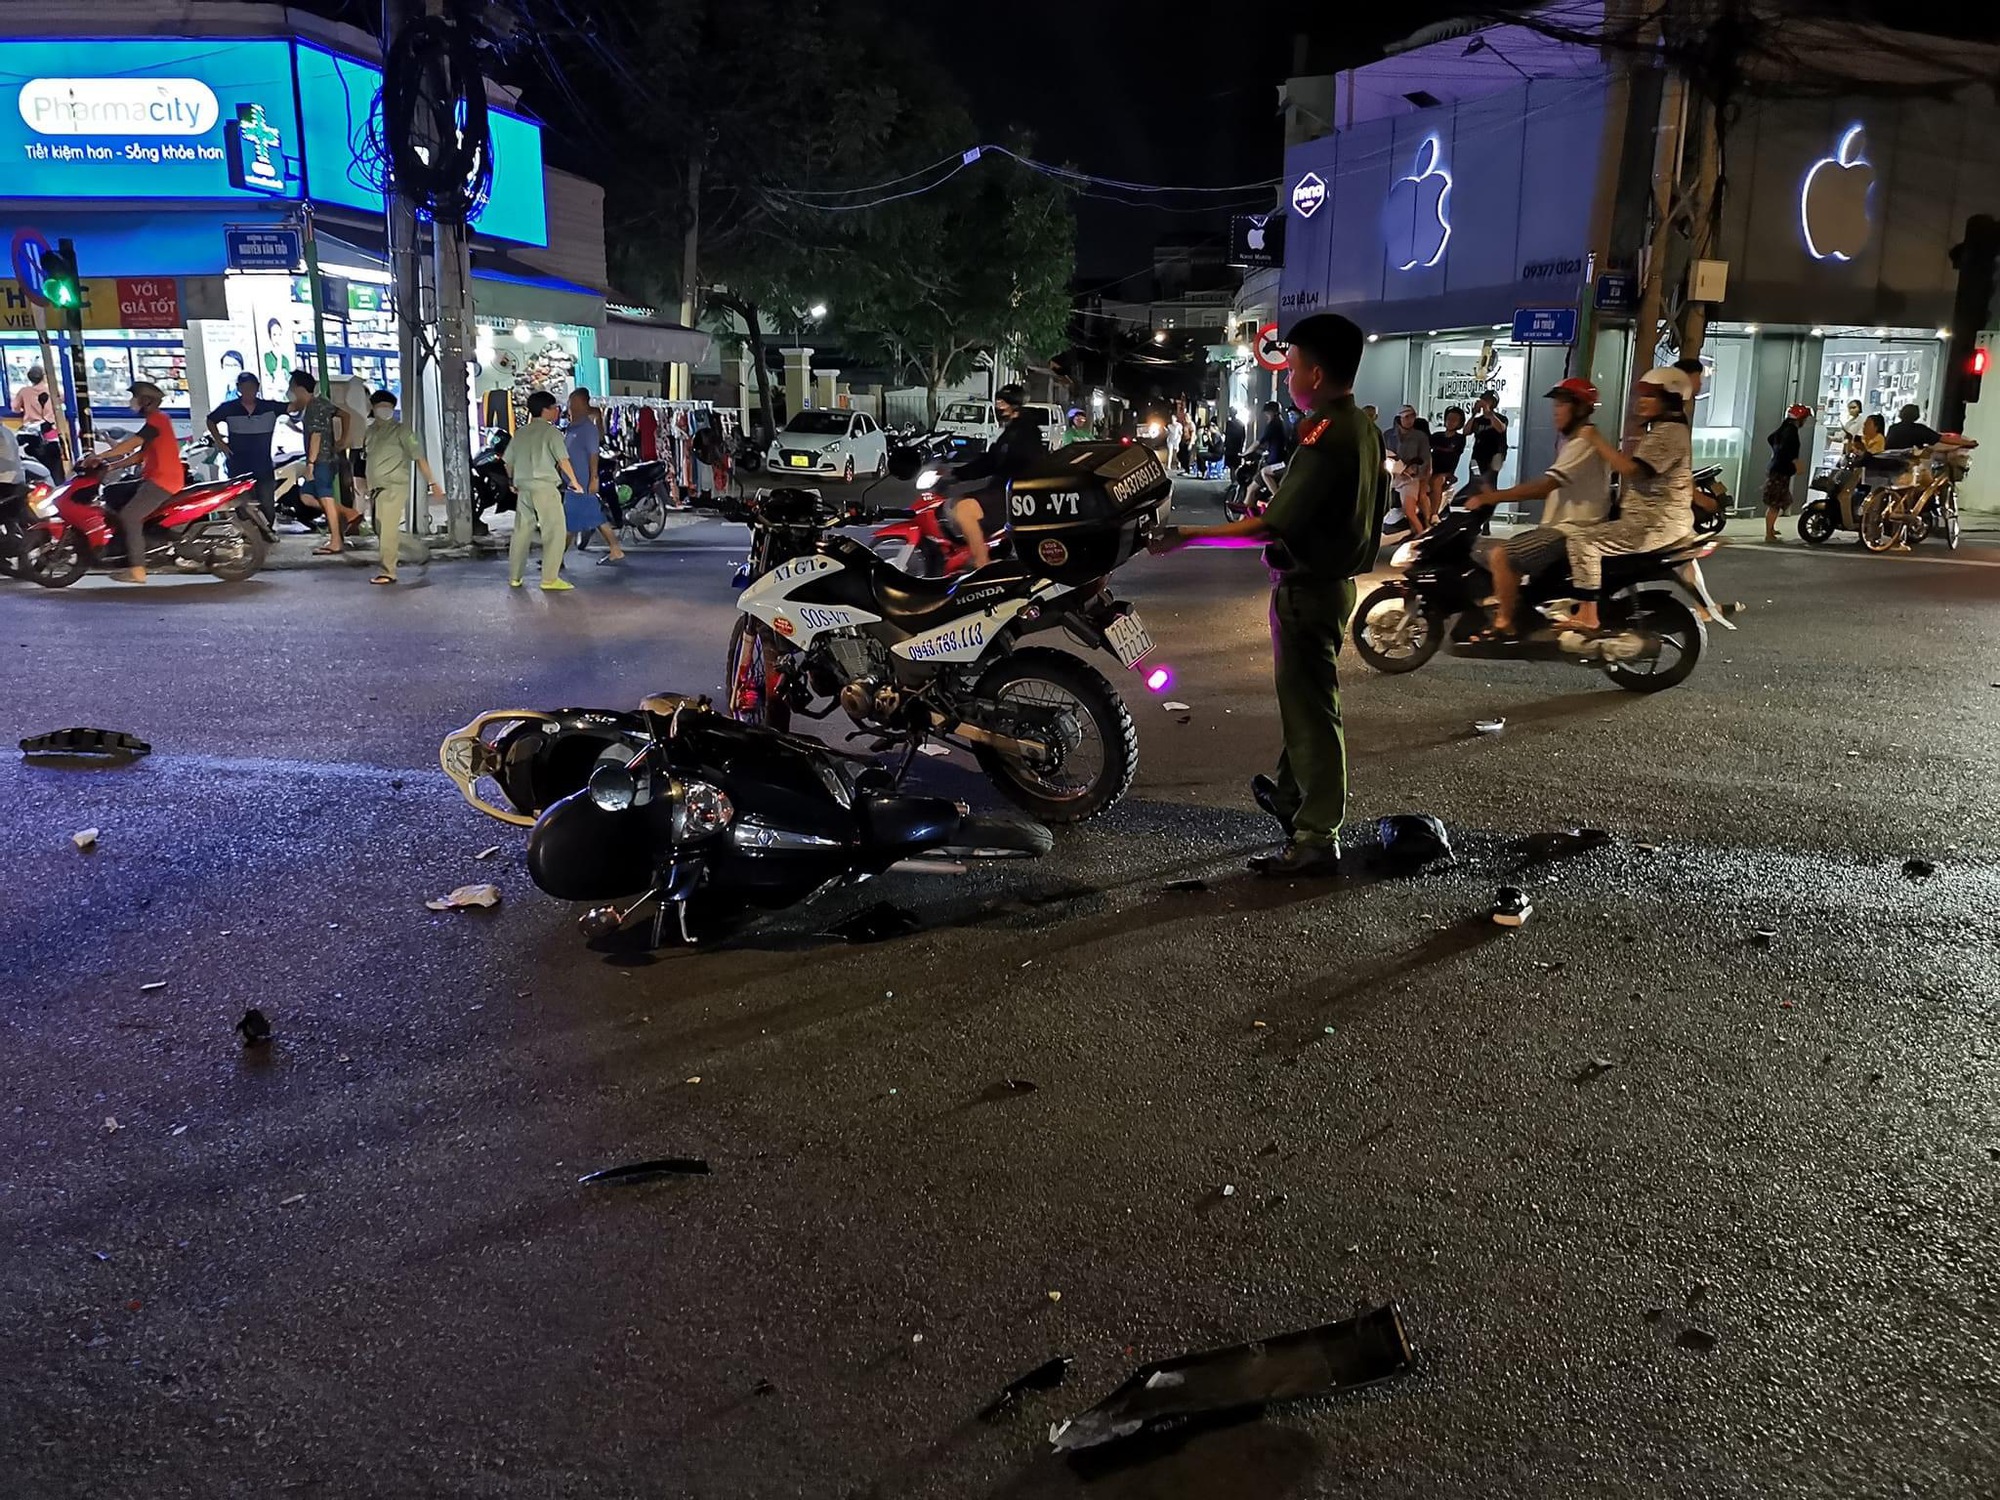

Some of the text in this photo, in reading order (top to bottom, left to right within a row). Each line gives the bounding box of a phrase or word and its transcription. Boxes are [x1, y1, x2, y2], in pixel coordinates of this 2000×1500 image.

[34, 95, 200, 128] Pharmacity
[24, 142, 48, 159] Tiết
[51, 143, 84, 162] kiệm
[86, 143, 113, 160] hơn
[125, 142, 159, 163] Sống
[197, 143, 224, 160] hơn
[121, 297, 176, 314] GIÁ TỐT
[1113, 461, 1161, 502] 0943789113
[956, 585, 1006, 606] HONDA
[799, 607, 850, 630] SOS-VT
